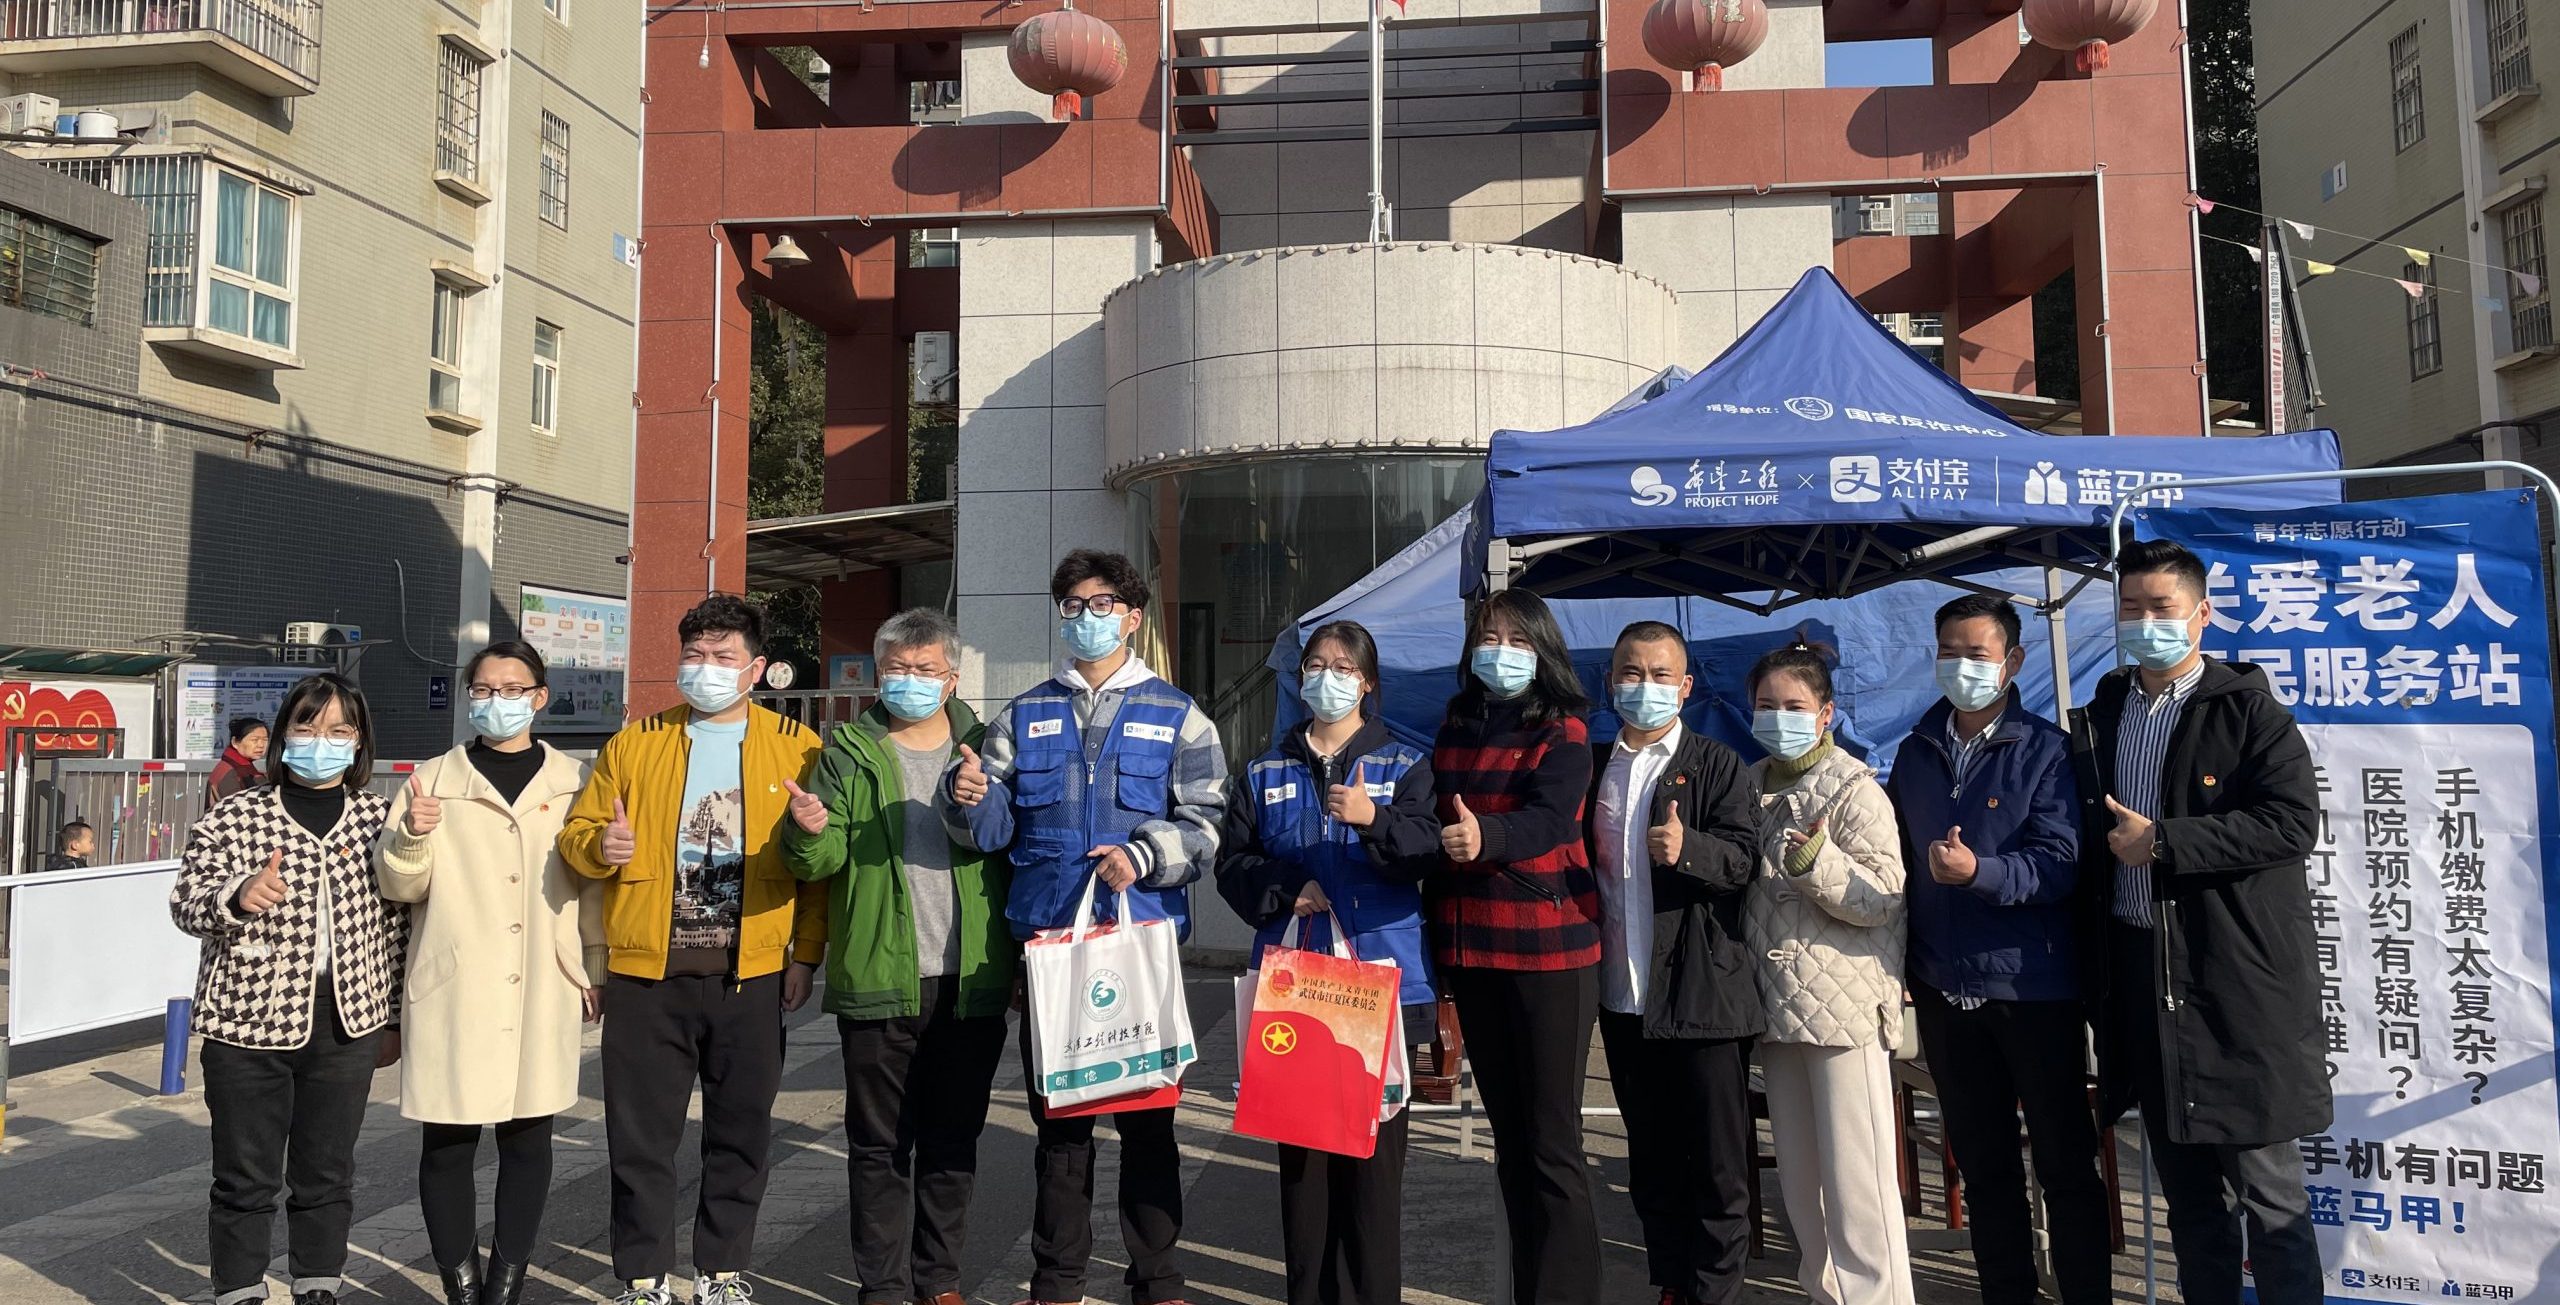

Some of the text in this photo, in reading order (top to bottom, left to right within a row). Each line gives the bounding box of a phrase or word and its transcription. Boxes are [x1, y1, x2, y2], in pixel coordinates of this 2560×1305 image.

[629, 245, 636, 265] 2
[1844, 407, 2008, 438] 国家反诈中心
[1685, 486, 1968, 508] PROJECT HOPE ALIPAY
[1887, 457, 1969, 486] 支付宝
[2077, 468, 2184, 507] 蓝马甲
[2252, 518, 2407, 543] 青年志愿行动
[2200, 642, 2521, 707] 民服务站
[2361, 768, 2421, 1100] 医院预约有疑问？
[2435, 767, 2497, 1105] 手机缴费太复杂？
[1299, 987, 1377, 1011] 武汉市江夏区委员会
[2300, 1135, 2545, 1194] 手机有问题
[2304, 1185, 2466, 1234] 蓝马甲！
[2368, 1274, 2420, 1292] 支付宝
[2465, 1283, 2514, 1300] 蓝马甲
